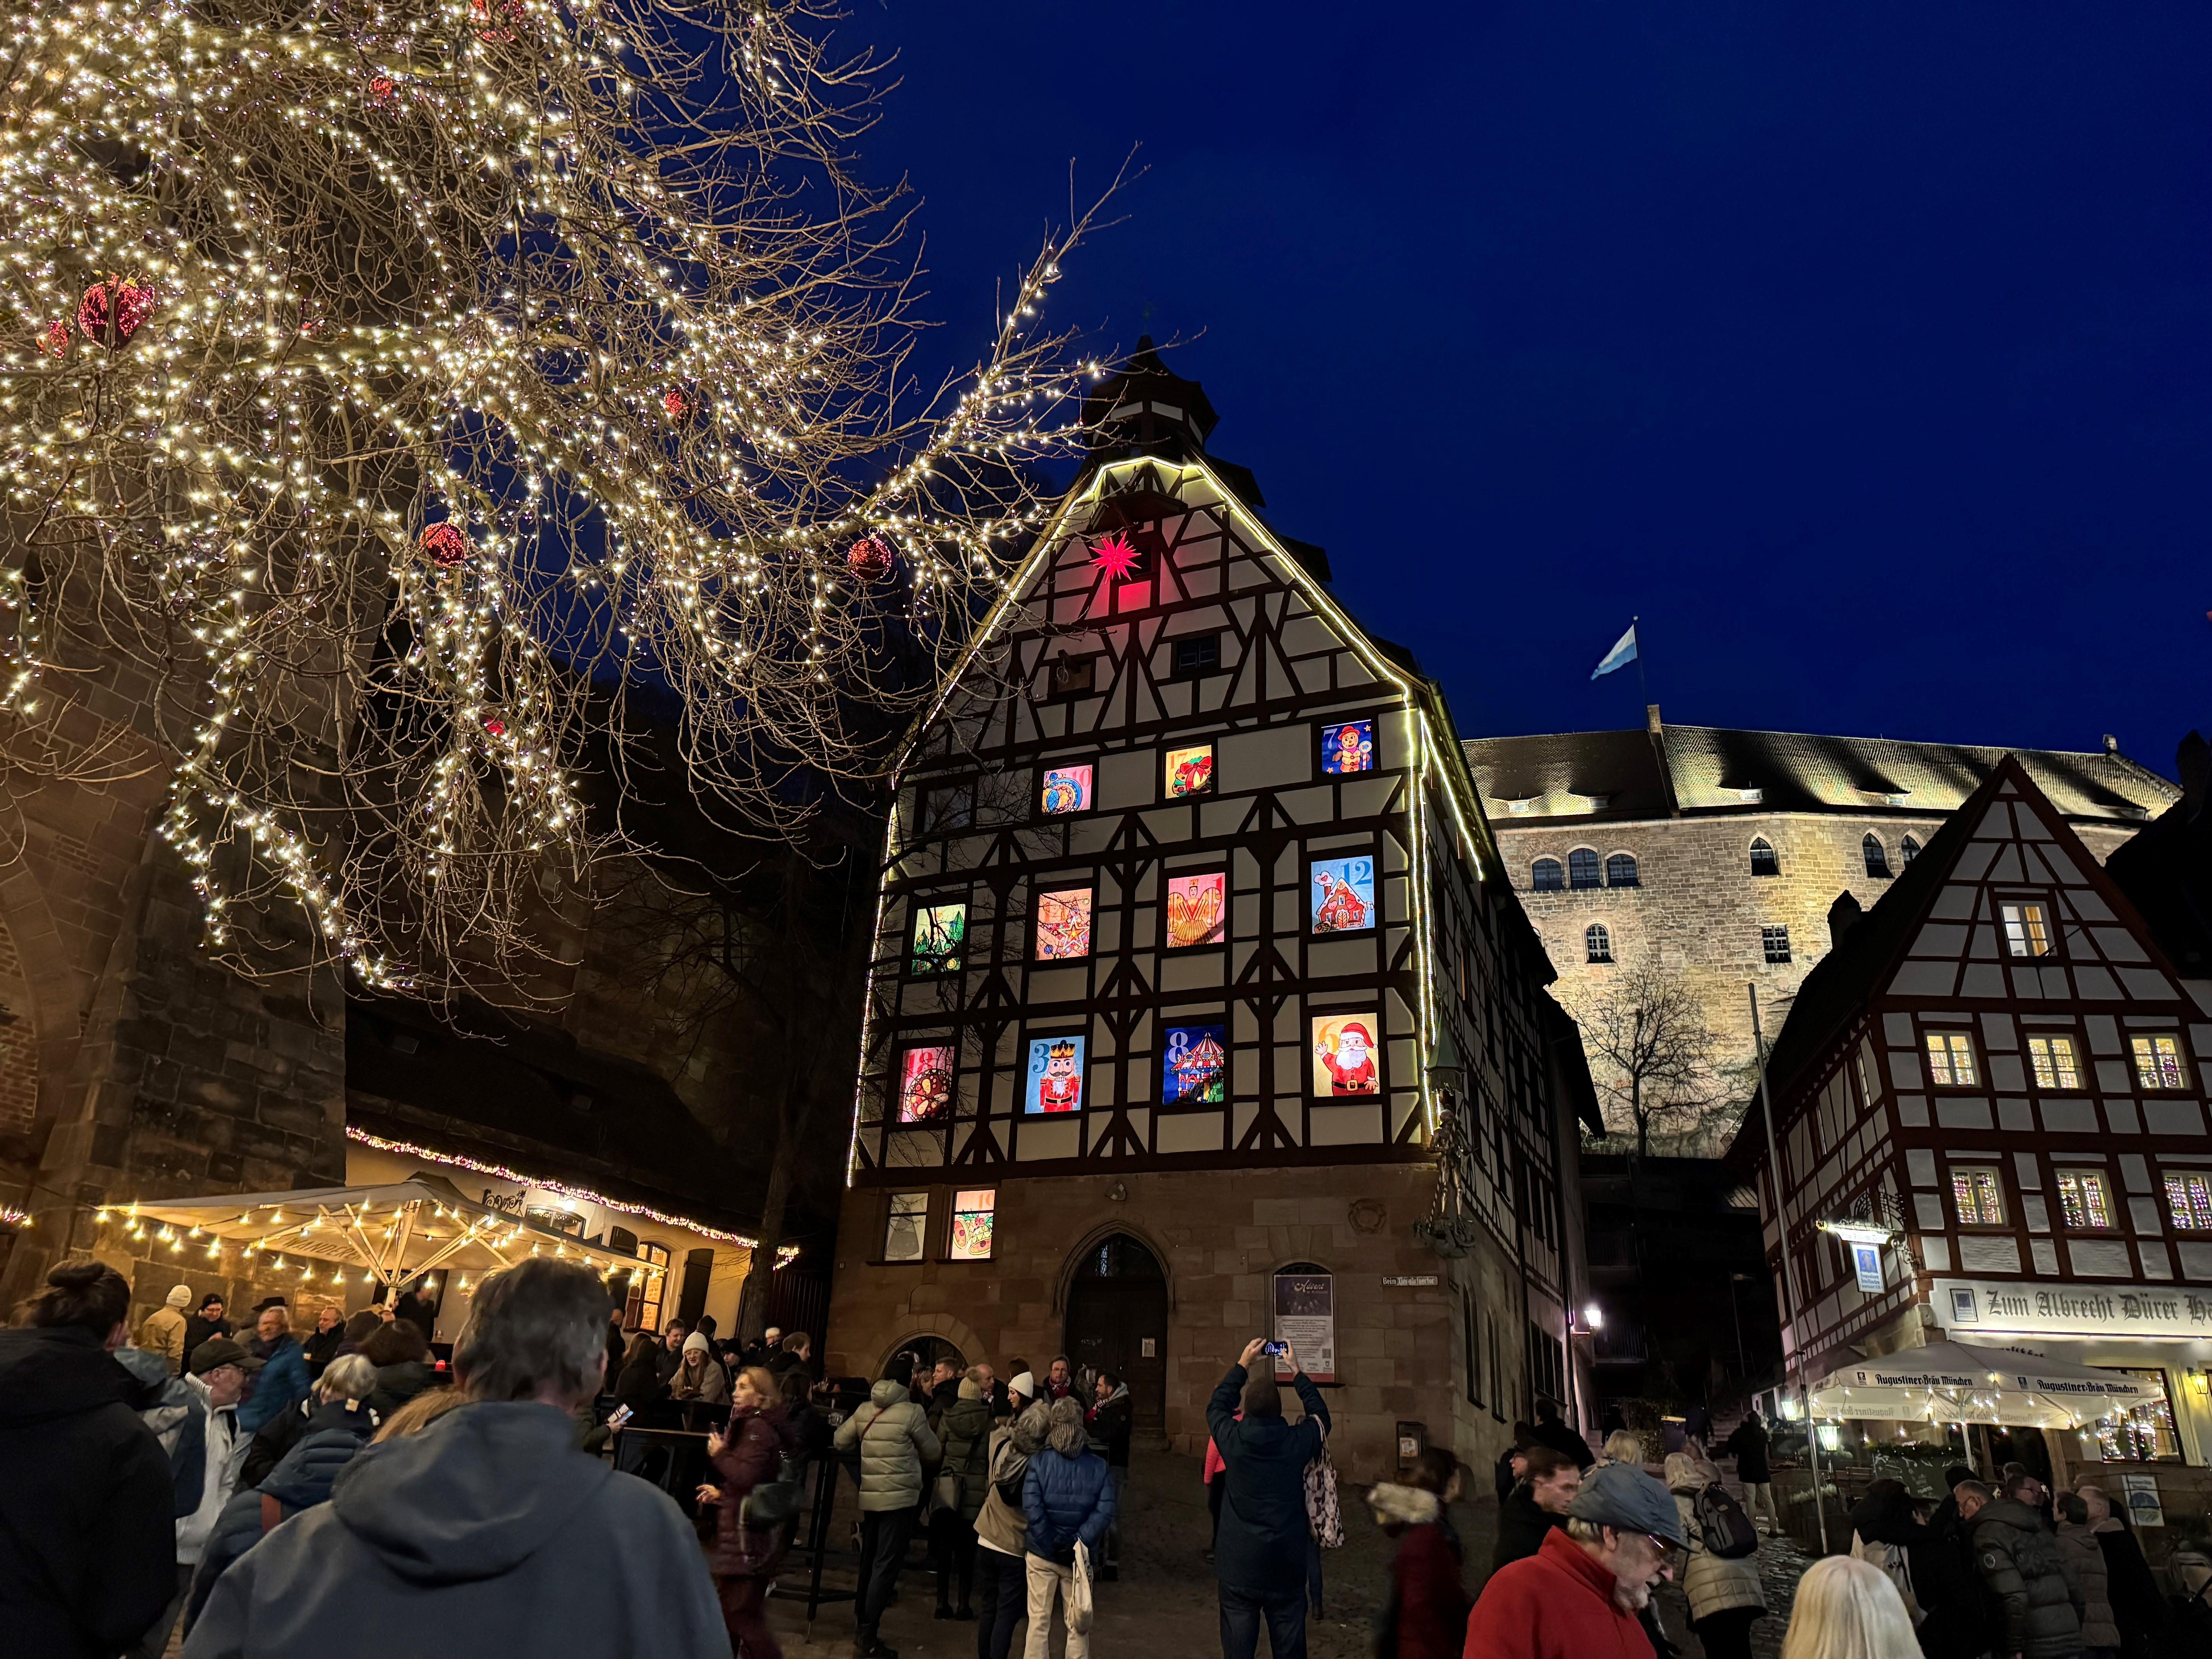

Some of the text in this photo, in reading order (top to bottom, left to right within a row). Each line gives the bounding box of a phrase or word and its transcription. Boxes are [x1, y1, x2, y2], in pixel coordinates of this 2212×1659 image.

[1324, 728, 1337, 749] 7
[1170, 752, 1187, 769] 17
[1072, 768, 1092, 787] 10
[1341, 861, 1372, 885] 12
[1168, 1032, 1189, 1063] 8
[1318, 1022, 1339, 1053] 6
[1032, 1043, 1050, 1073] 3
[1295, 1279, 1324, 1293] Advent
[1986, 1290, 2030, 1316] Zum
[2035, 1291, 2115, 1323] Albrecht
[2118, 1293, 2178, 1321] Dürer
[1941, 1376, 1973, 1386] München
[2105, 1383, 2138, 1394] München
